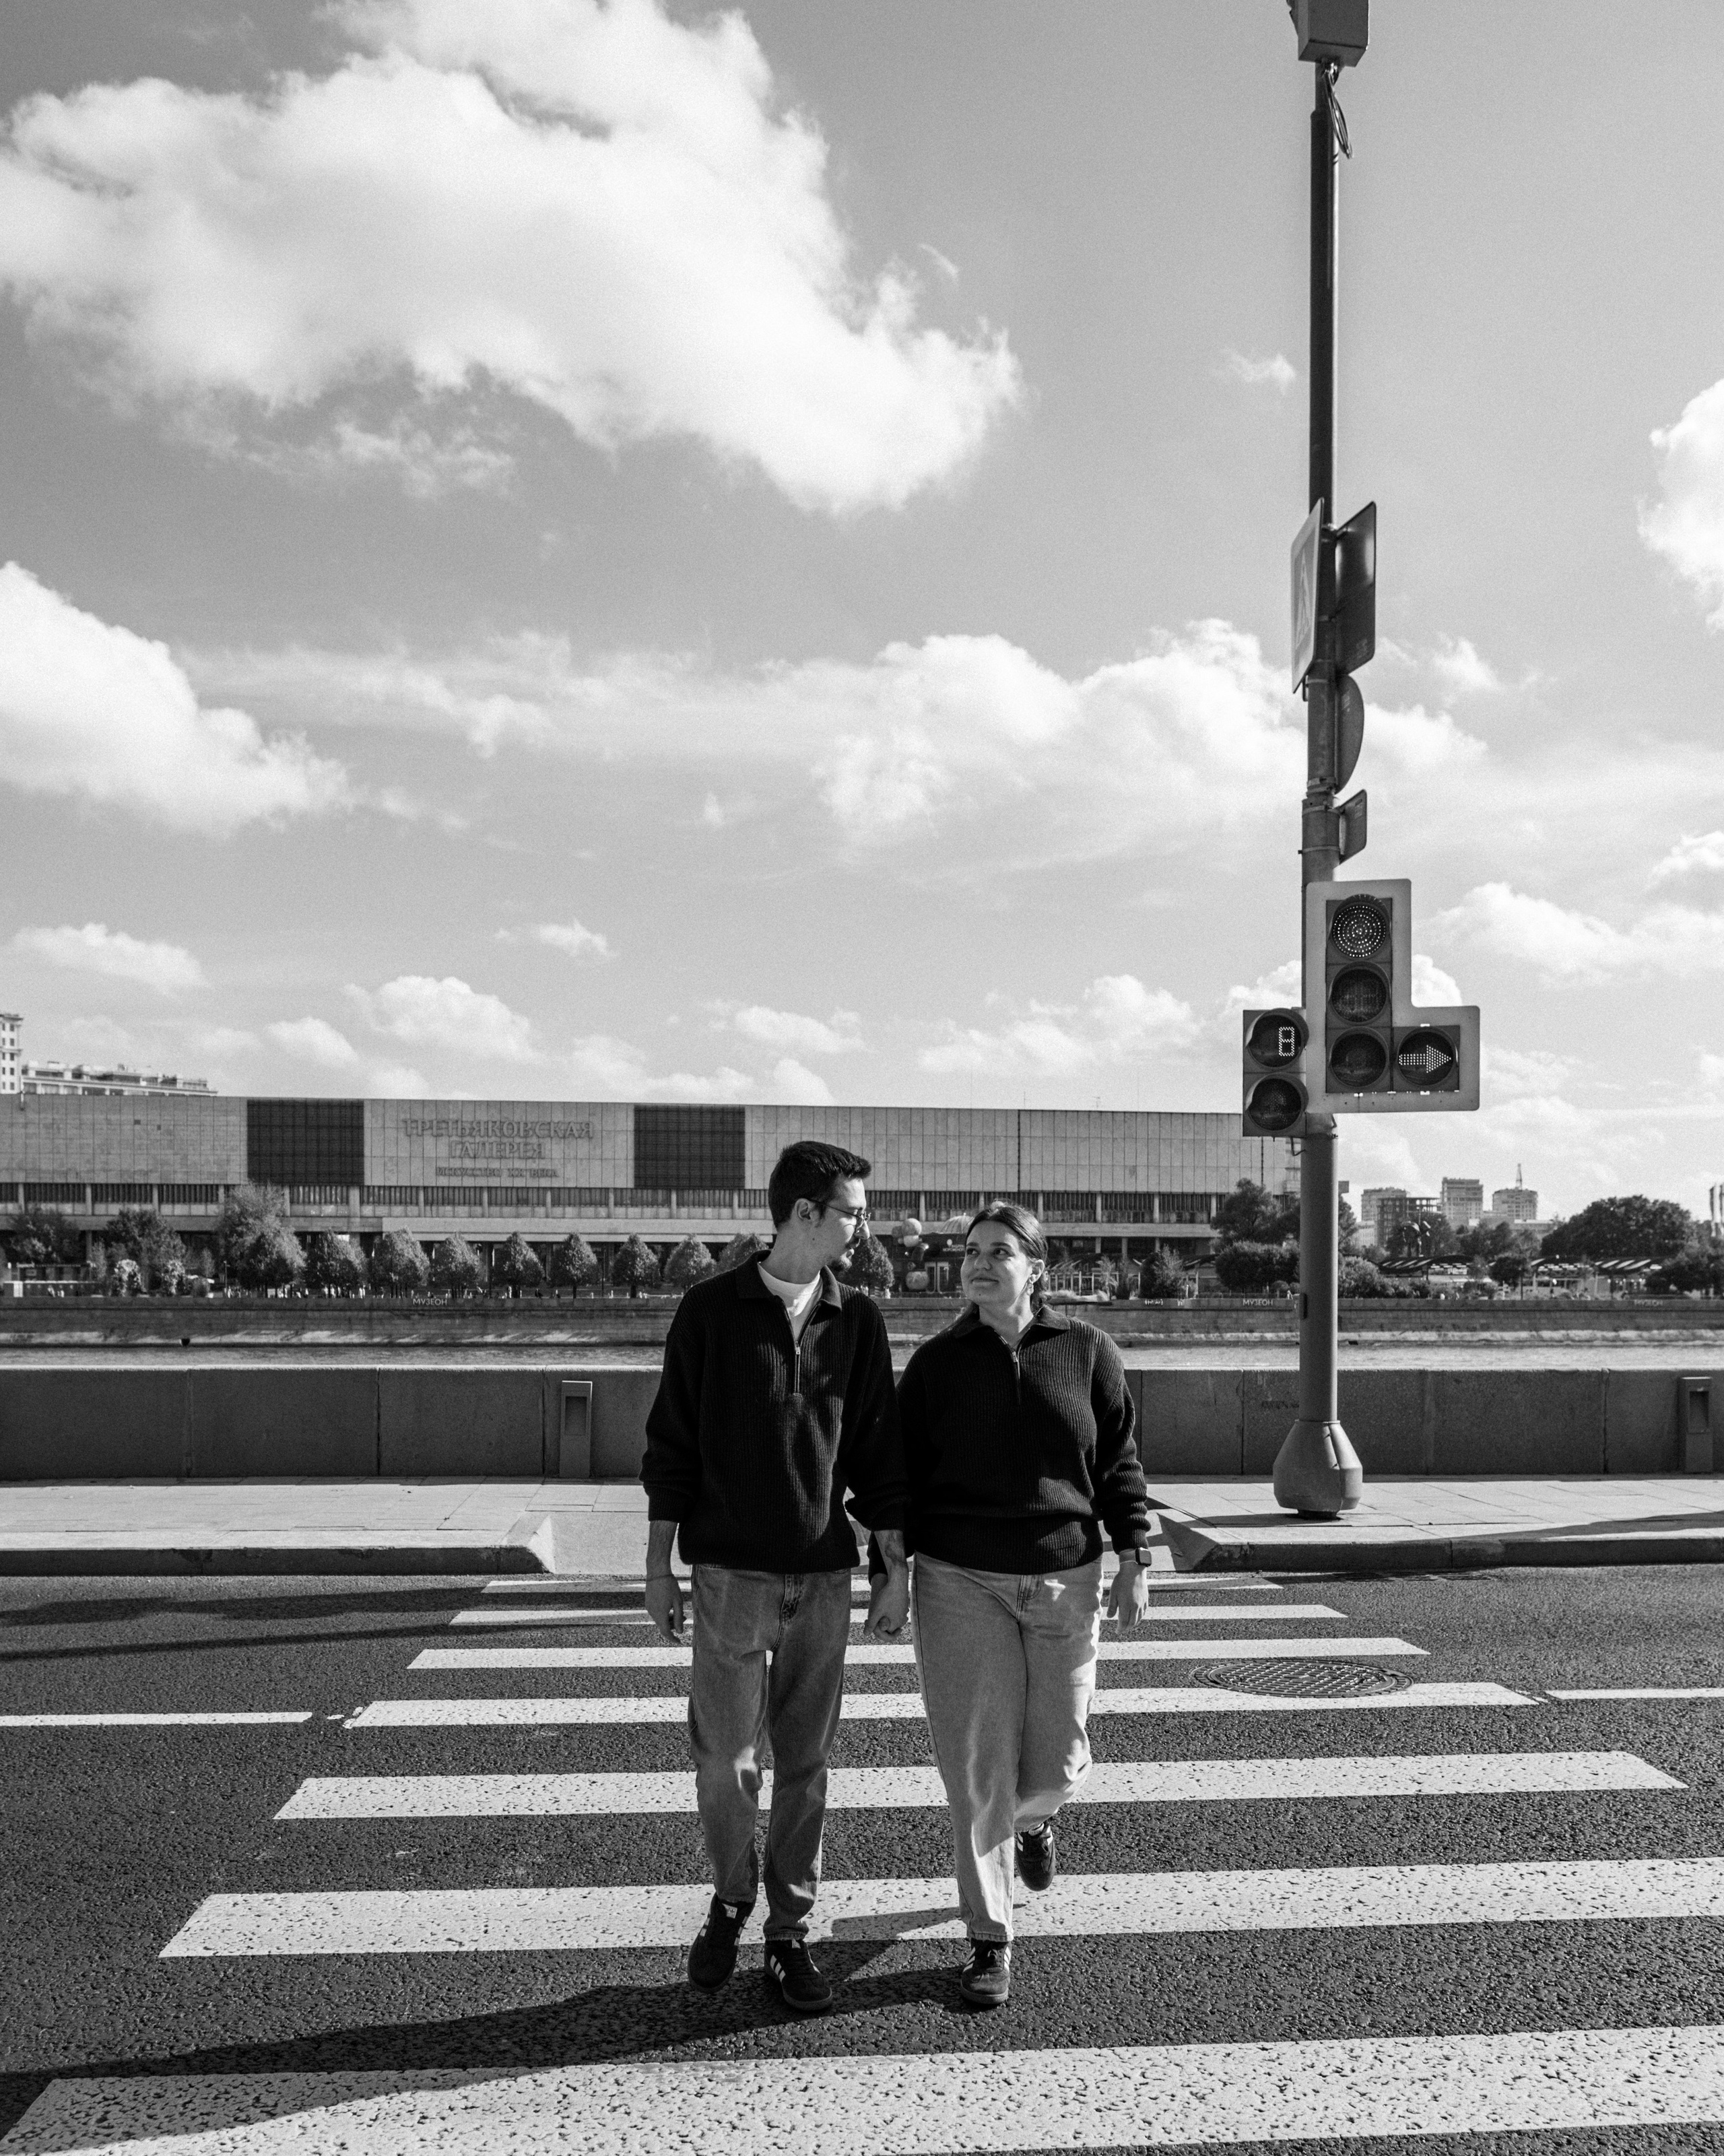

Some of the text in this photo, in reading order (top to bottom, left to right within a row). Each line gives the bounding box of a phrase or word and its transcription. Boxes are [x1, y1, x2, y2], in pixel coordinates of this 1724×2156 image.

[1279, 1026, 1294, 1056] 8
[403, 1118, 593, 1139] ТРЕТЬЯКОВСКАЯ
[450, 1140, 546, 1159] ГАЛЕРЕЯ
[436, 1167, 502, 1177] ИСКУССТВО
[529, 1168, 559, 1178] ВЕКА
